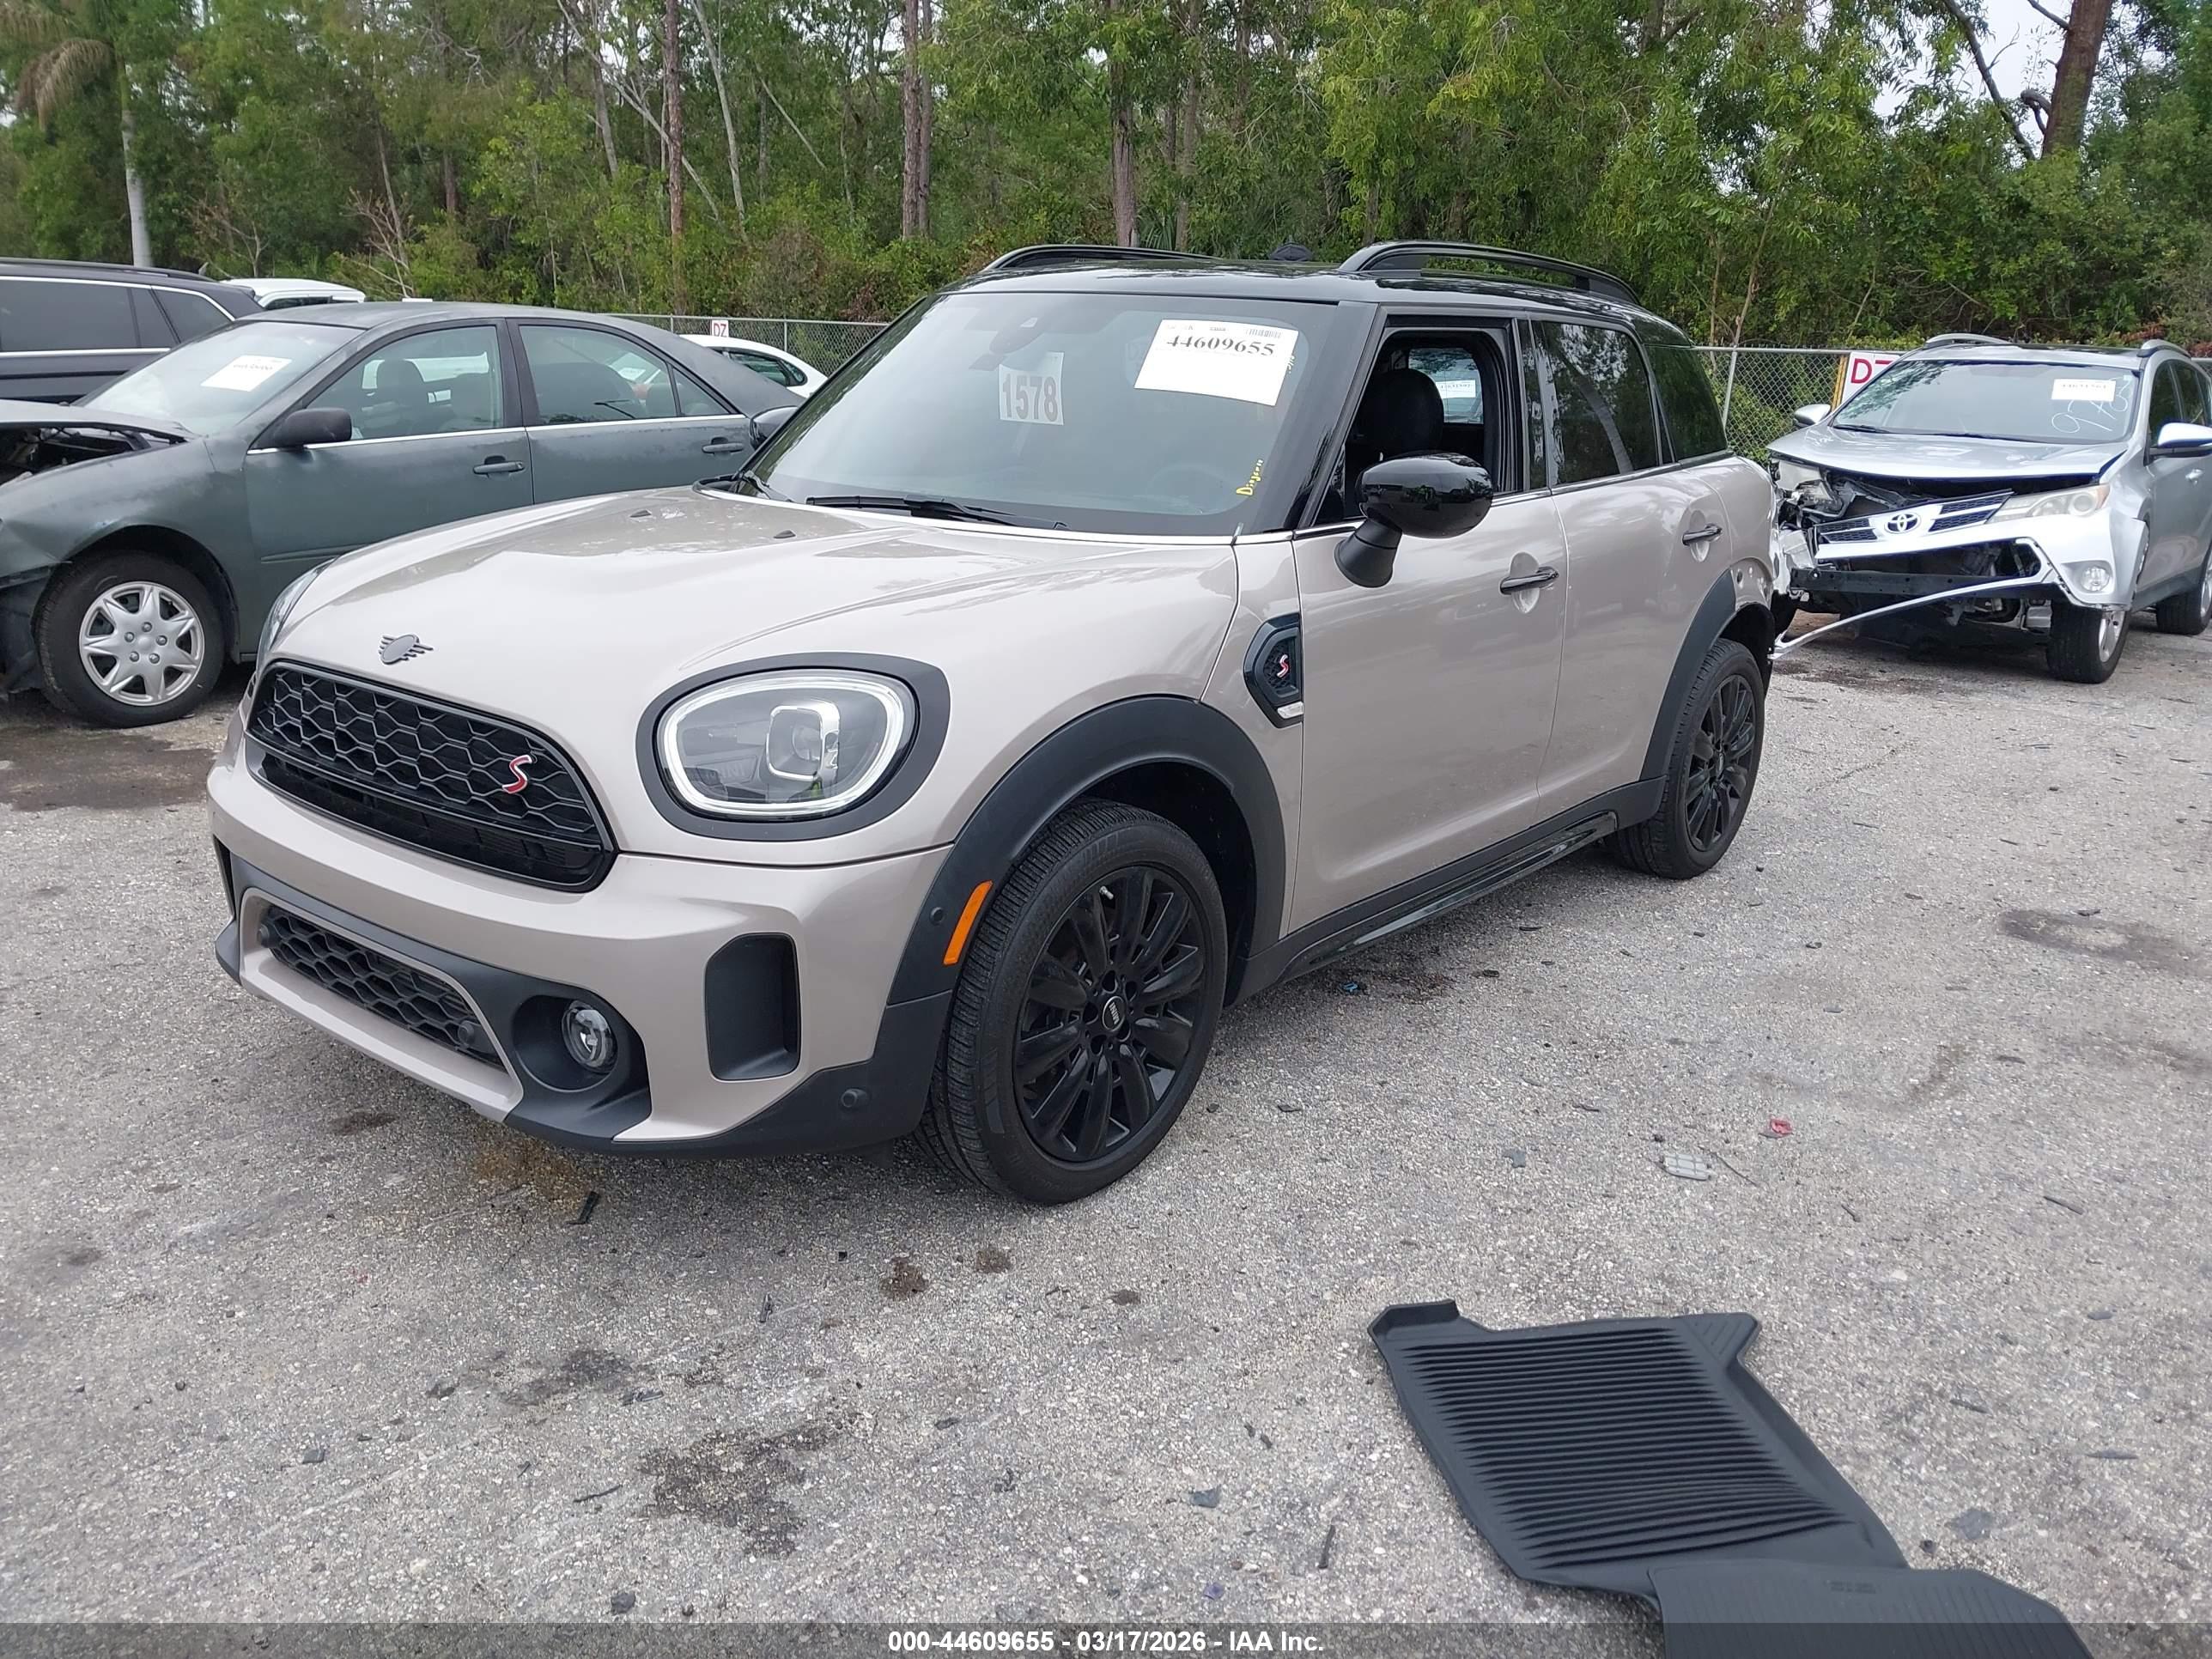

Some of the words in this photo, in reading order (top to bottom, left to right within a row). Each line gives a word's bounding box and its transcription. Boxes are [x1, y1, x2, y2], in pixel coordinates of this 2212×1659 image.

[1167, 335, 1276, 356] 44609655
[1002, 373, 1058, 422] 1578
[502, 754, 532, 794] S
